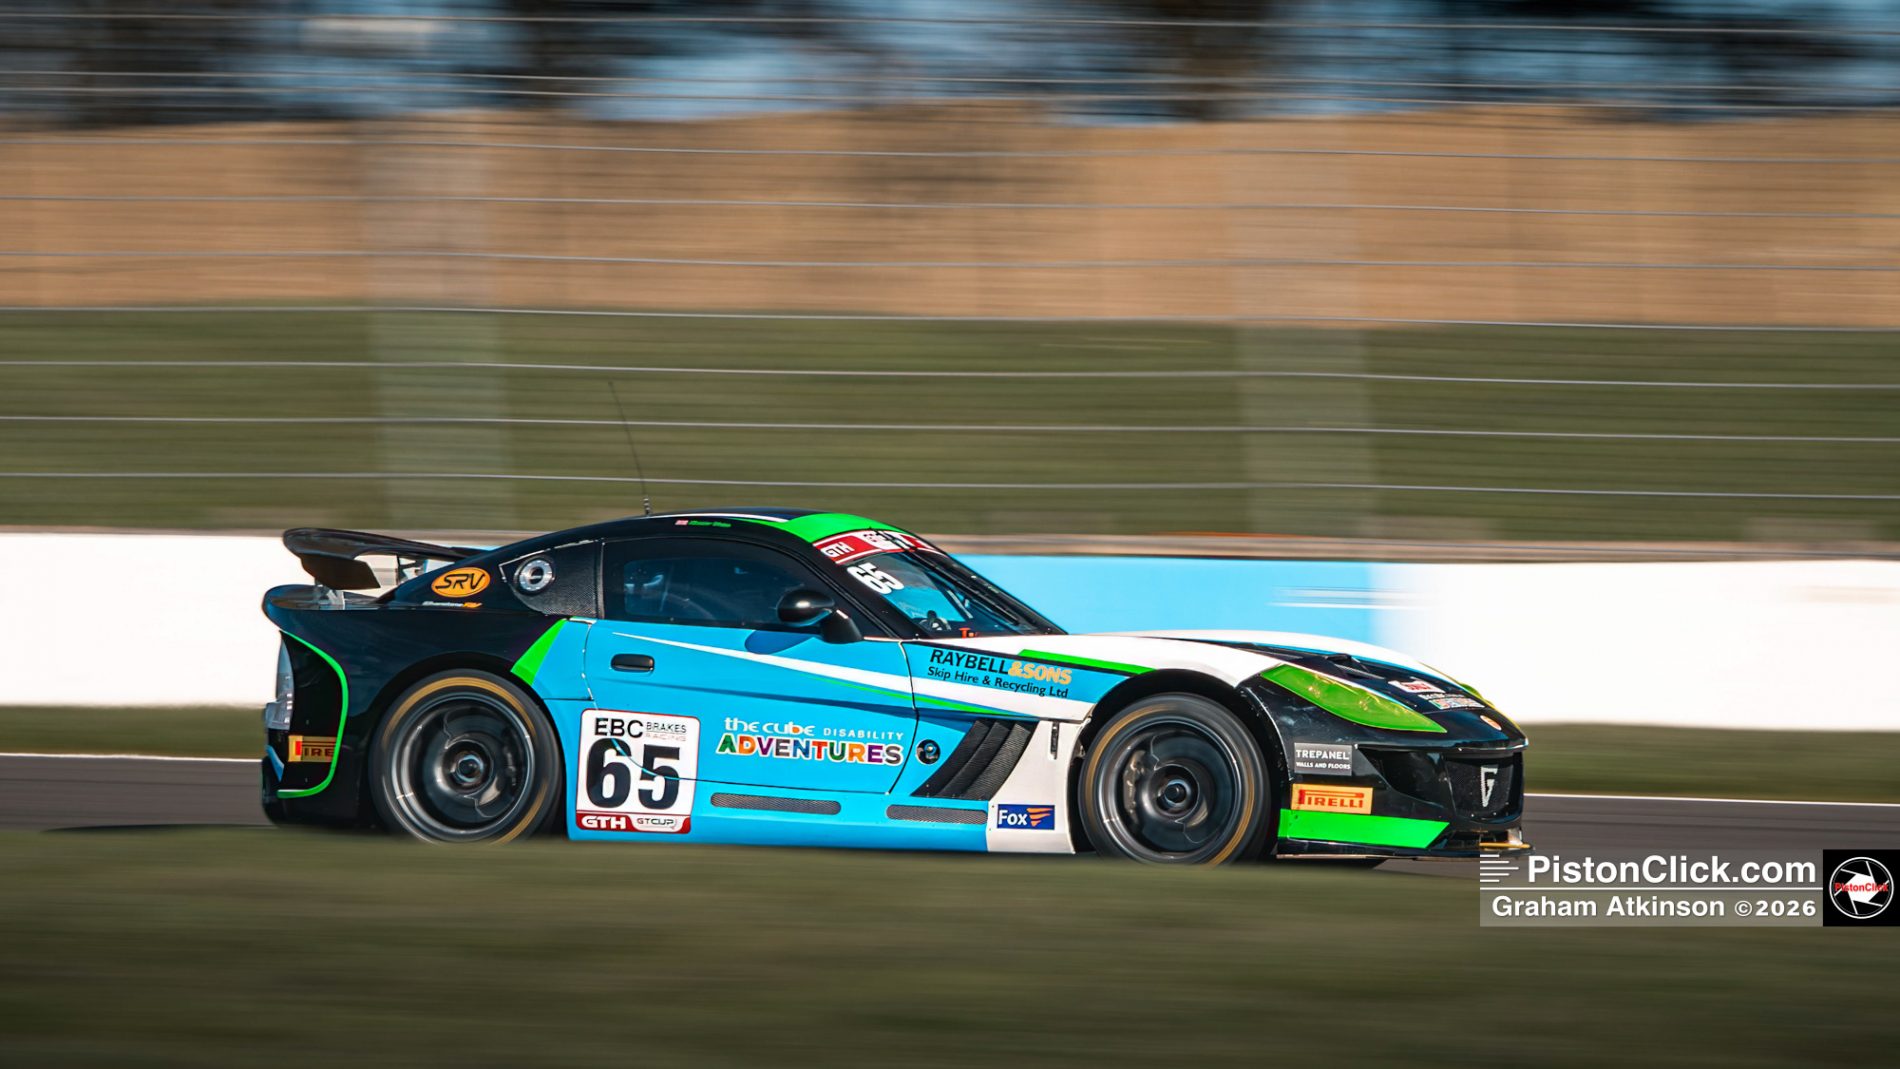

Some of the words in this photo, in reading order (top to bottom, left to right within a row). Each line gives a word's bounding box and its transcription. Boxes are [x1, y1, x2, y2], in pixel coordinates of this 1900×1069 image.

[821, 541, 855, 558] GTH
[435, 573, 486, 590] SRV
[847, 562, 905, 595] 65
[927, 666, 951, 680] Skip
[954, 670, 979, 684] Hire
[982, 675, 991, 686] &
[995, 677, 1047, 697] Recycling
[1050, 686, 1069, 699] Ltd
[594, 717, 644, 739] EBC
[646, 721, 687, 734] BRAKES
[724, 717, 760, 733] the
[762, 721, 816, 737] cube
[823, 728, 905, 741] DISABILITY
[717, 733, 903, 765] ADVENTURES
[1296, 749, 1350, 760] TREPANEL
[586, 737, 681, 811] 65
[1328, 762, 1351, 770] FLOORS
[1298, 788, 1365, 809] PIRELLI
[581, 815, 627, 830] GTH
[998, 808, 1028, 826] Fox
